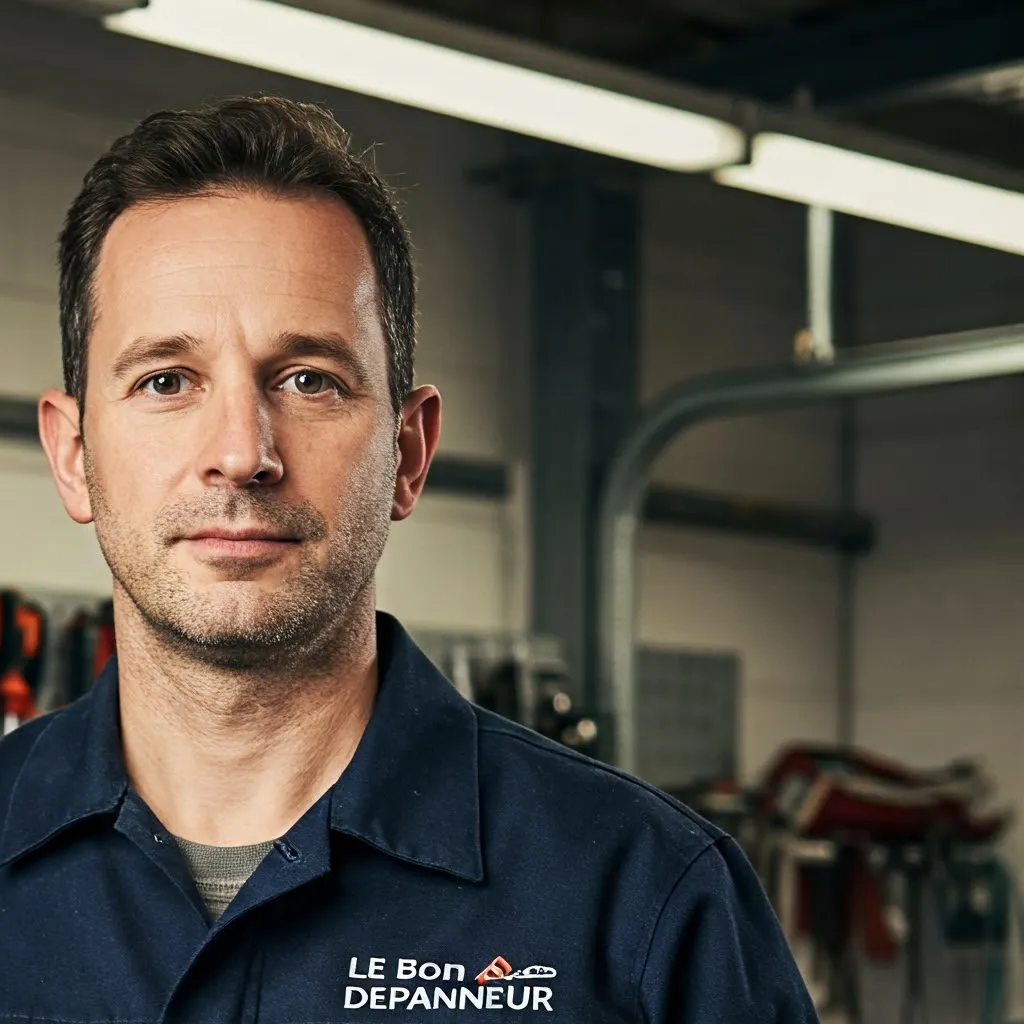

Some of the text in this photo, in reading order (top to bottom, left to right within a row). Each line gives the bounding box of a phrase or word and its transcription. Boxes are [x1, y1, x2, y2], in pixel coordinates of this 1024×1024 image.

[348, 956, 466, 982] LE Bon
[343, 985, 554, 1012] DEPANNEUR
